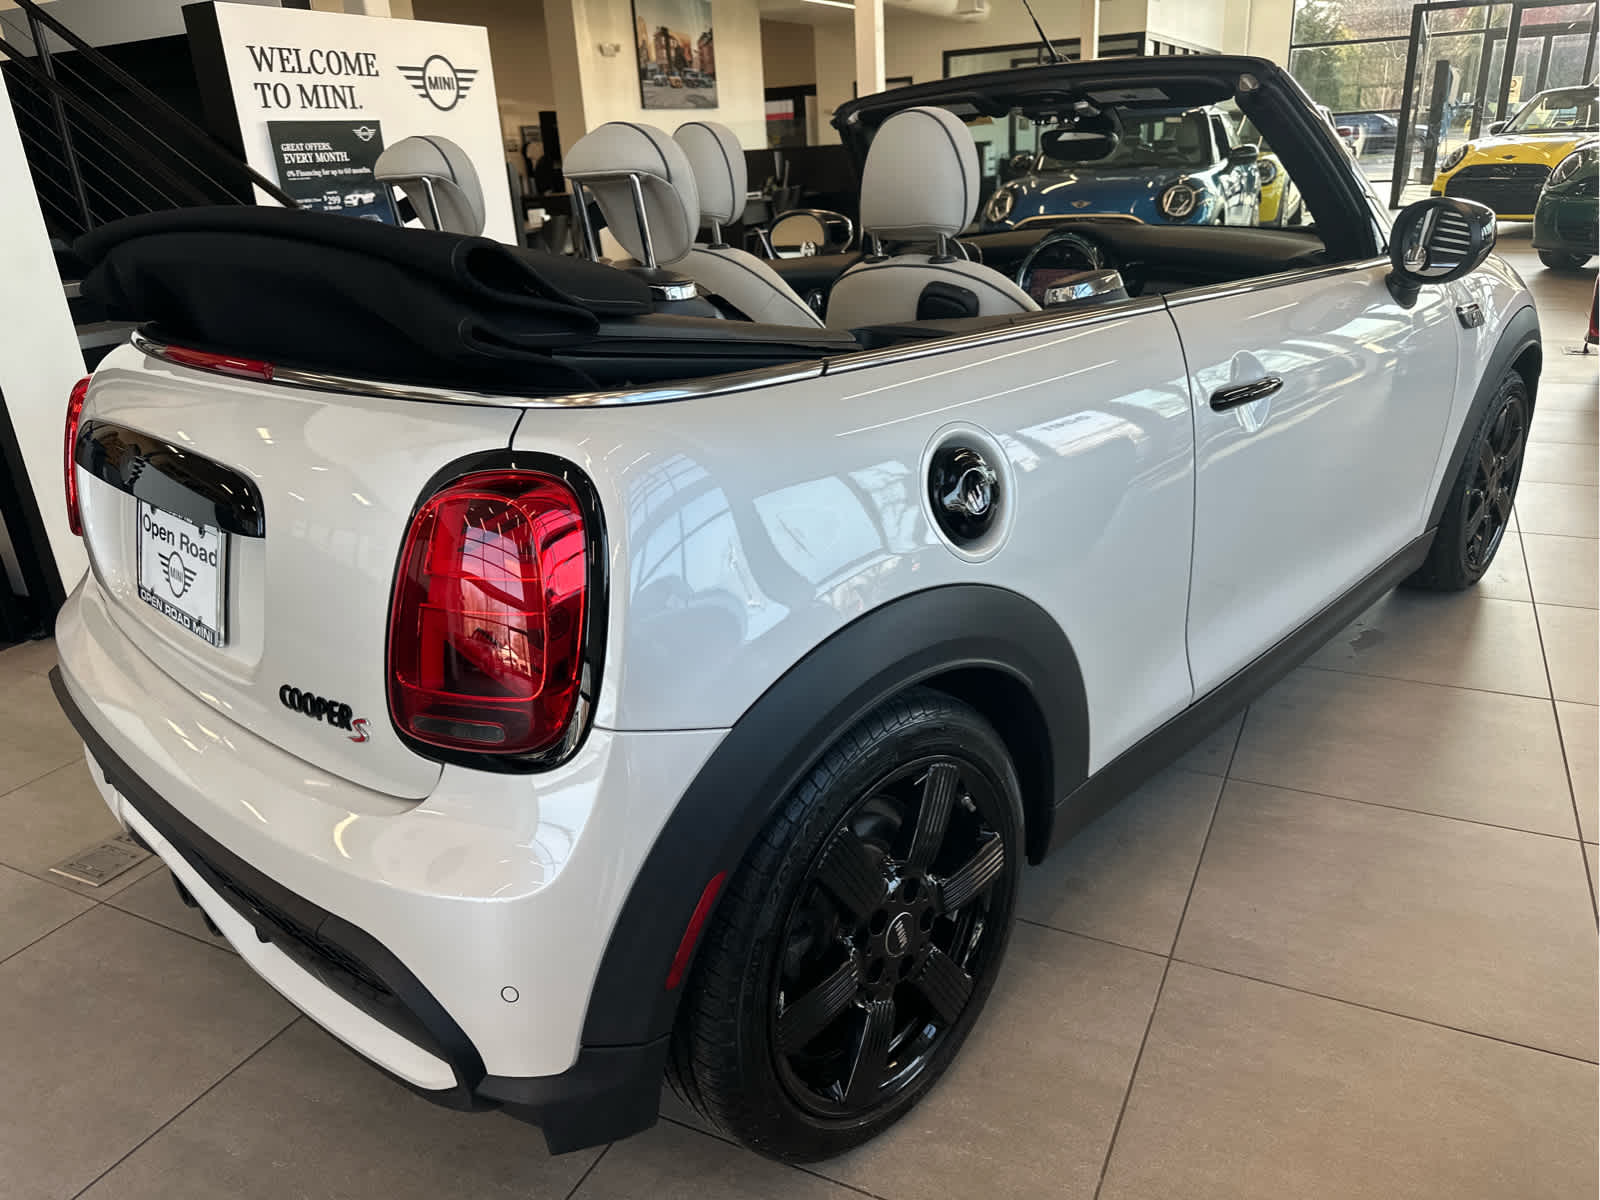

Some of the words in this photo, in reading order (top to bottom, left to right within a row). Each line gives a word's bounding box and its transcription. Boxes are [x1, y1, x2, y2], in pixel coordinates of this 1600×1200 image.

[245, 45, 379, 76] WELCOME
[254, 82, 291, 109] TO
[296, 83, 363, 109] MINI.
[428, 76, 455, 90] MINI
[281, 142, 304, 152] GREAT
[283, 153, 314, 164] EVERY
[315, 151, 350, 163] MONTH.
[142, 513, 175, 546] Open
[180, 532, 217, 568] Road
[170, 566, 184, 583] MINI
[140, 590, 163, 611] OPEN
[164, 604, 191, 629] ROAD
[192, 621, 214, 644] MINI
[279, 684, 353, 732] COOPER
[347, 718, 371, 743] S
